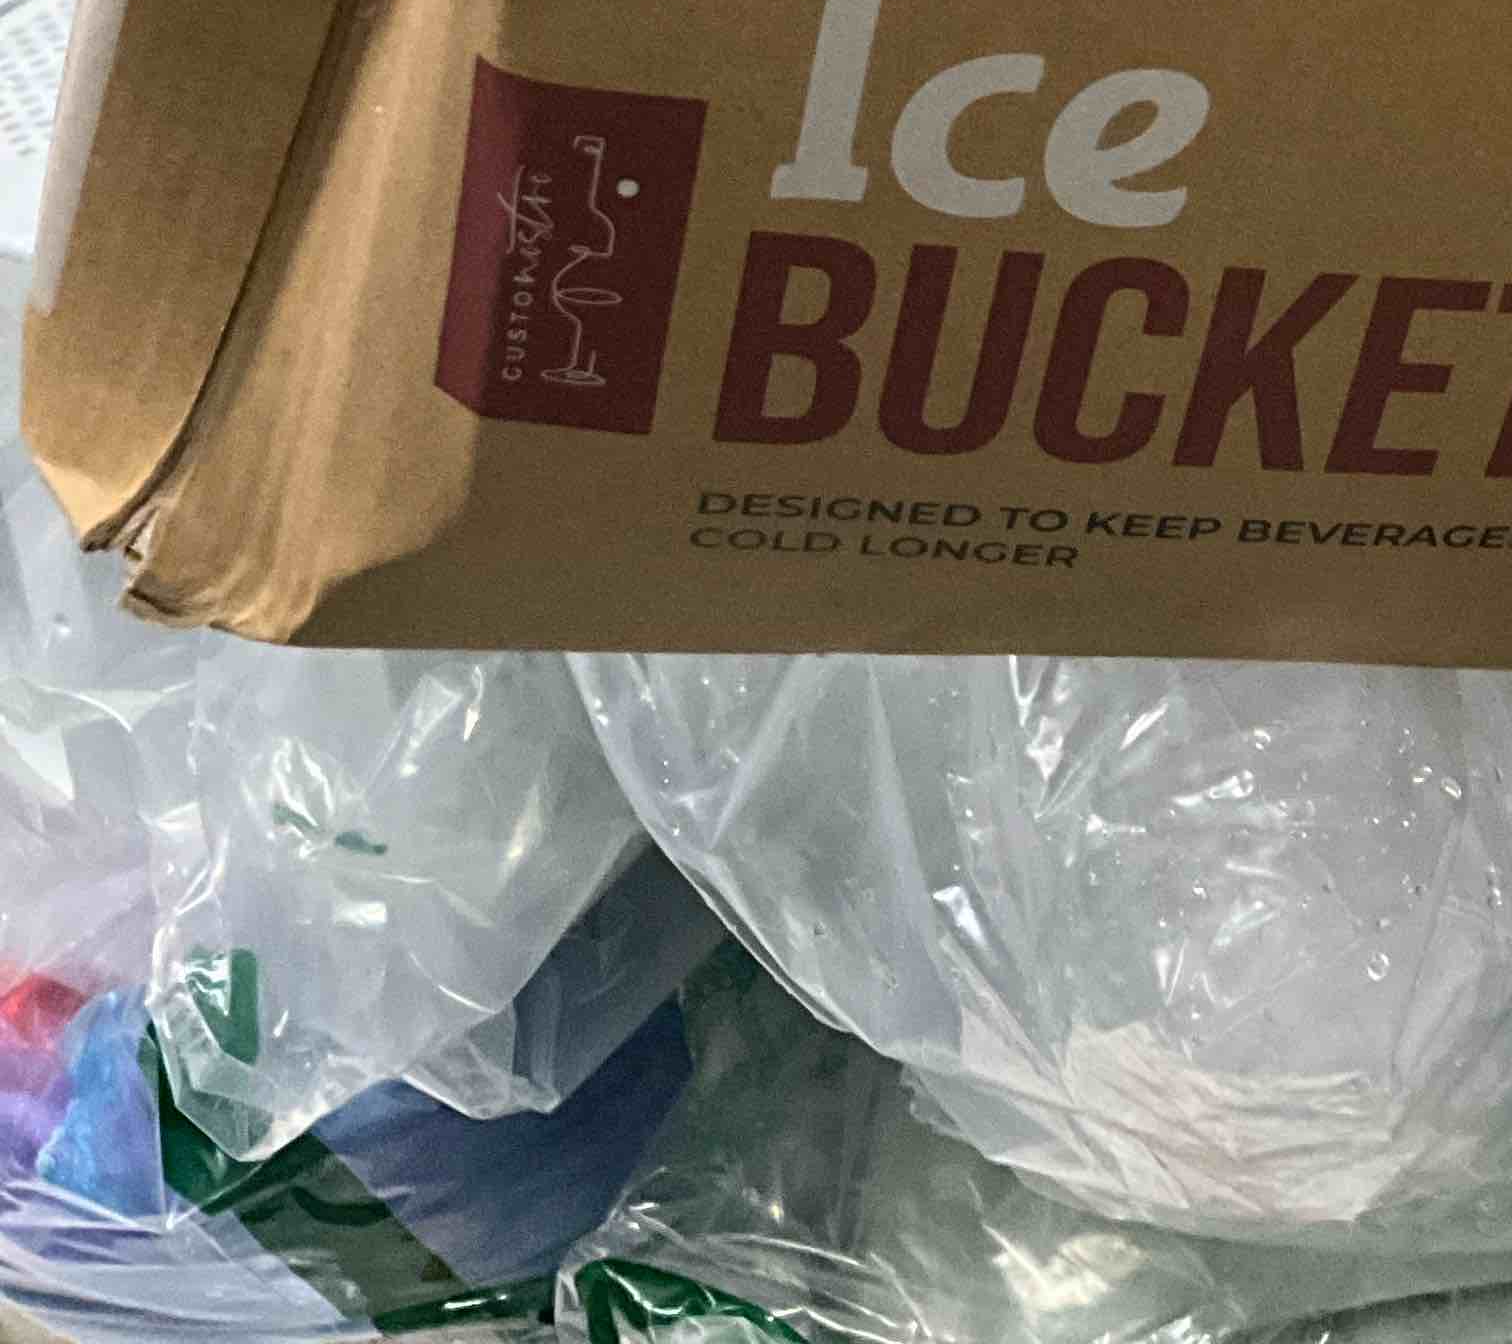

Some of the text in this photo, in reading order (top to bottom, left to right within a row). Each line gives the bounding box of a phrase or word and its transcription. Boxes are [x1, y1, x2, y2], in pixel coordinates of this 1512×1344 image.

[698, 491, 983, 528] DESIGNED
[1000, 506, 1070, 533] TO
[1085, 511, 1222, 541] KEEP
[689, 526, 1080, 569] COLD LONGER
